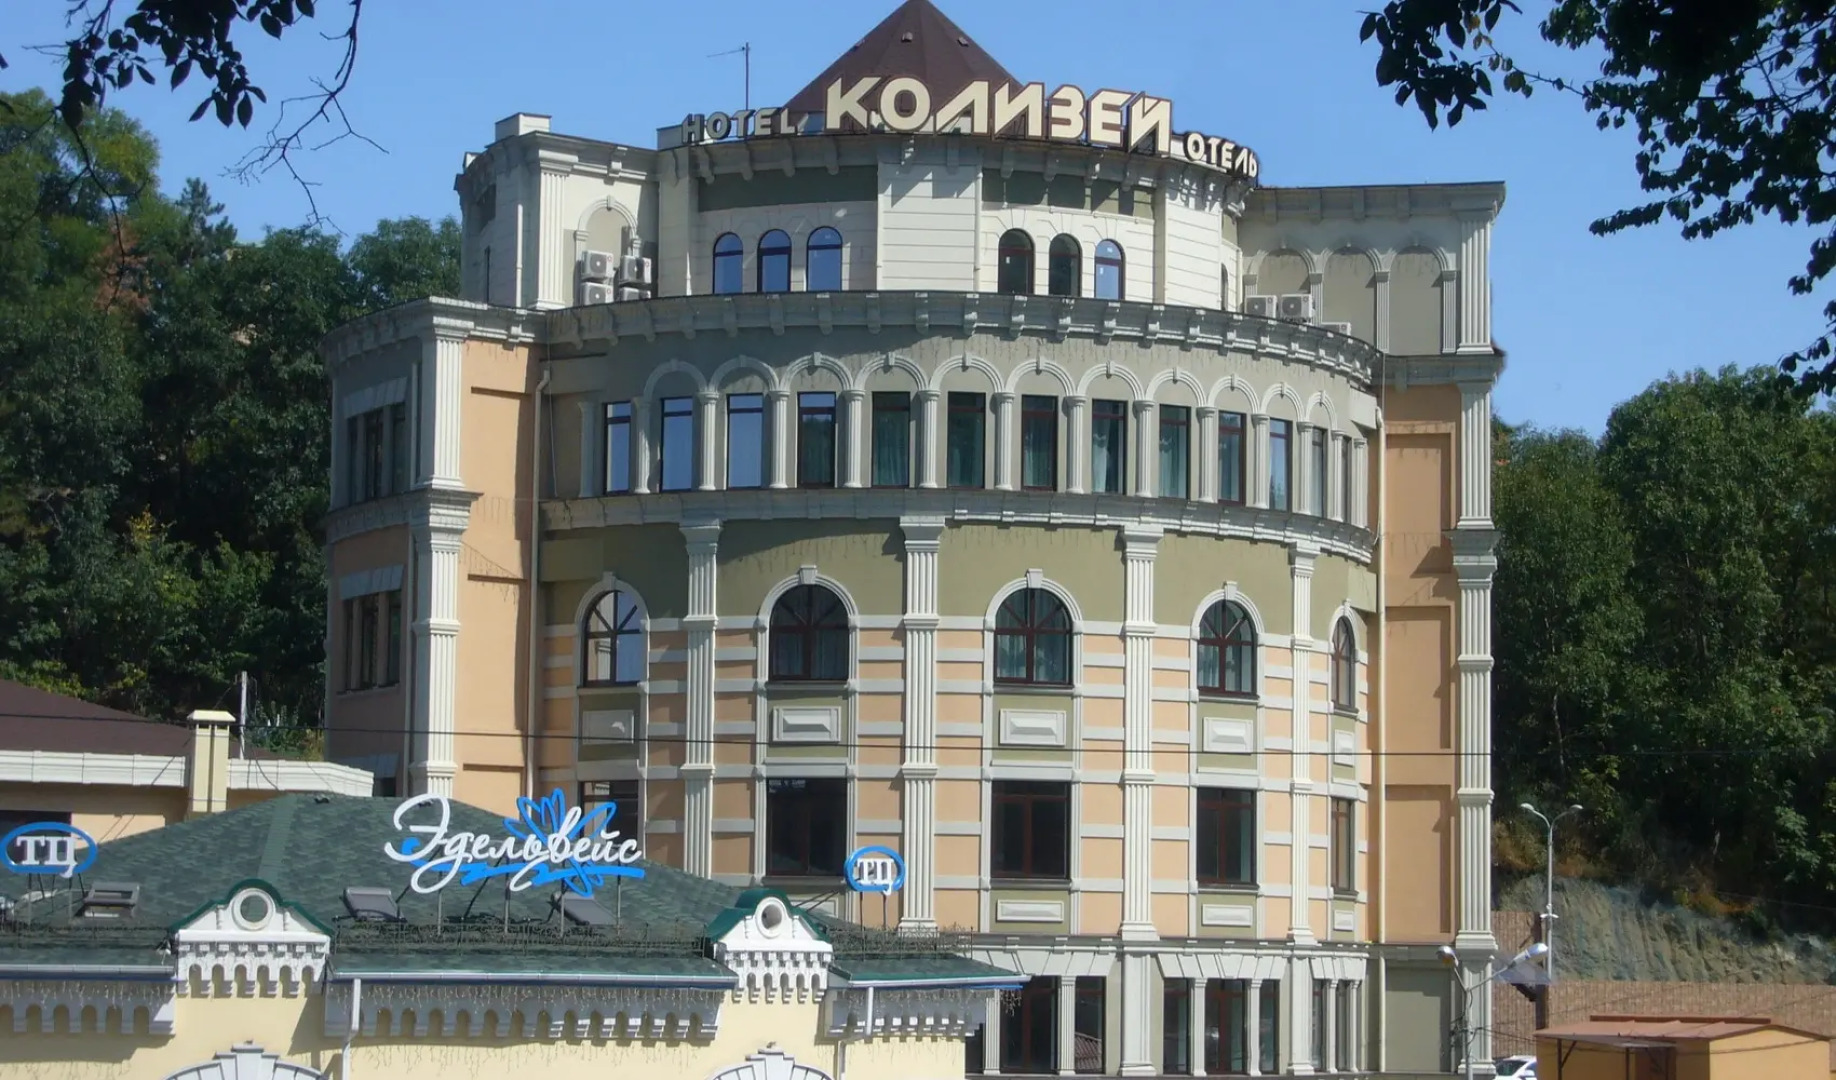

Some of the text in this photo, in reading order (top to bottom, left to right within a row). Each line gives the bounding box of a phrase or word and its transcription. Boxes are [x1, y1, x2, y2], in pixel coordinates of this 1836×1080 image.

[682, 75, 1259, 178] HOTEL КОЛИЗЕЙ ОТЕЛЬ
[16, 835, 78, 878] ТЦ
[384, 793, 642, 893] Эдельвейс
[857, 858, 894, 895] ТЦ
